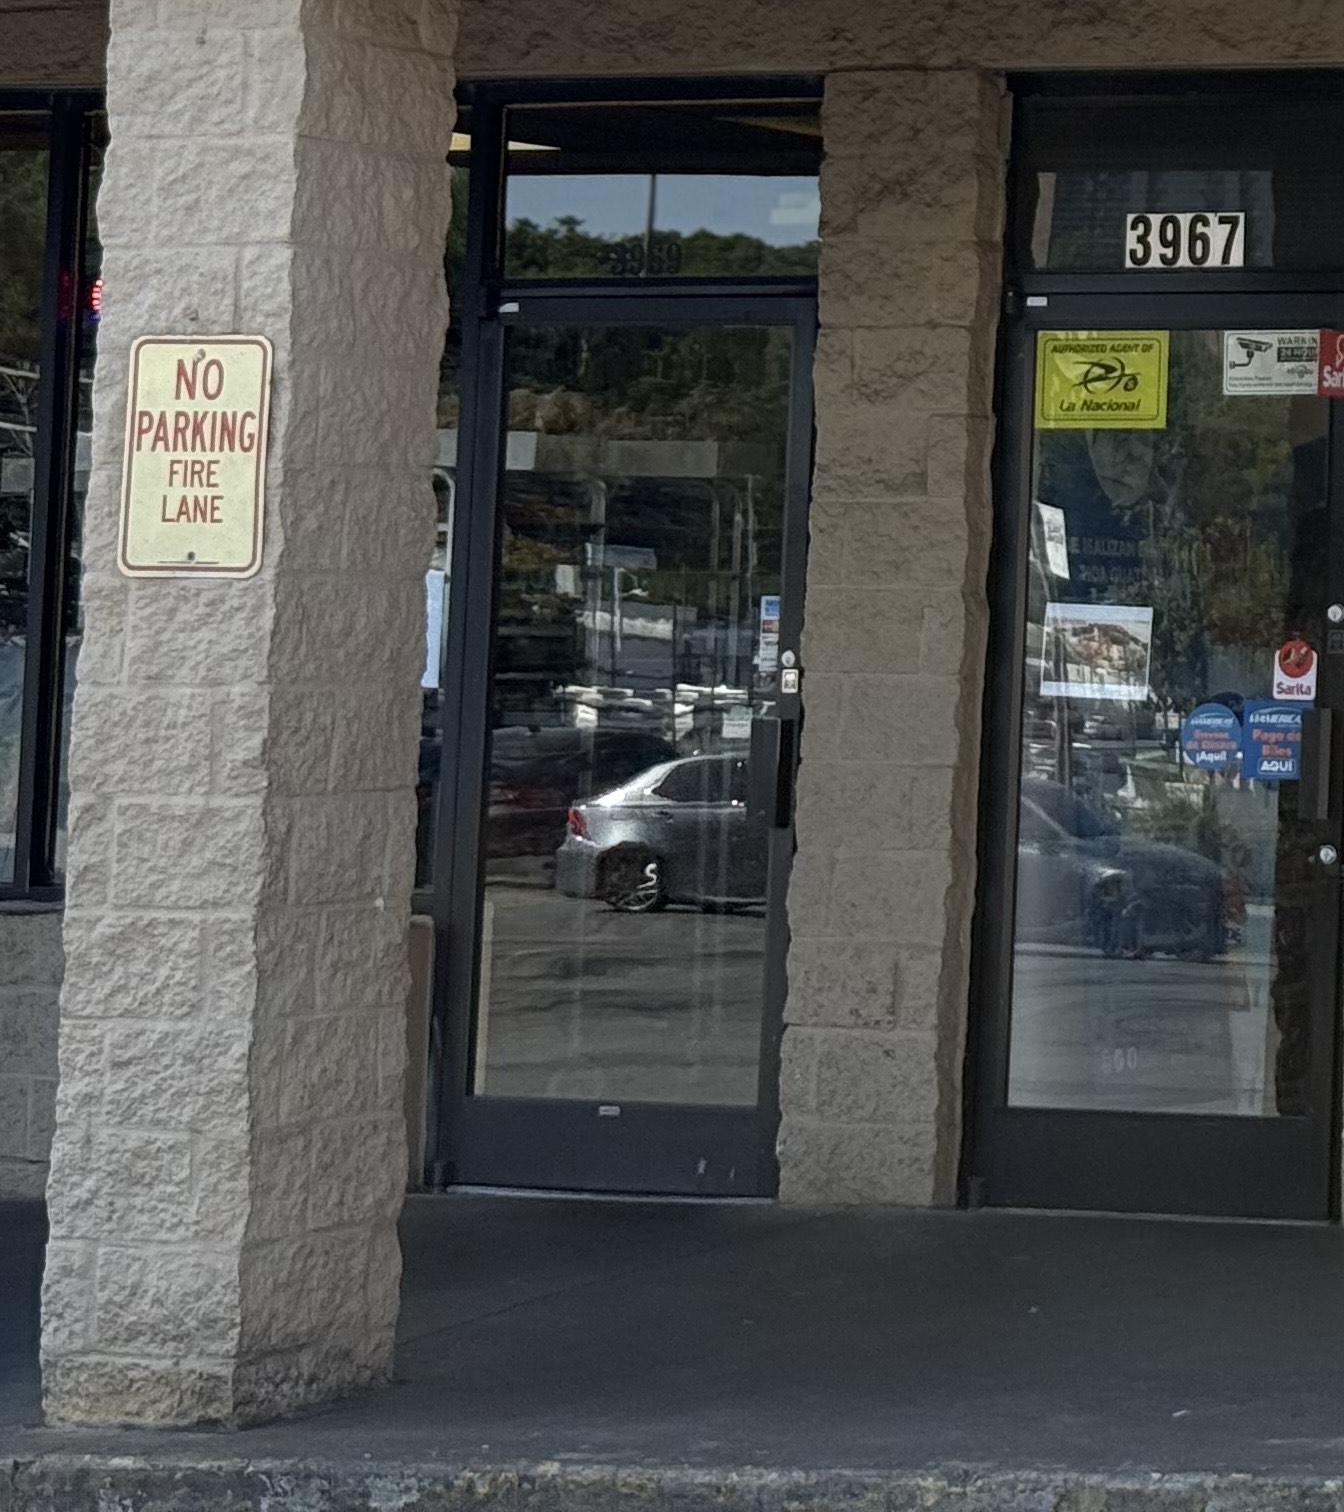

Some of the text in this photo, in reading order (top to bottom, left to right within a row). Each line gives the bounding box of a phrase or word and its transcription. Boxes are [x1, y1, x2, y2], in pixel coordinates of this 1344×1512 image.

[1129, 214, 1241, 266] 3967
[1051, 344, 1107, 353] AUTHORIZED
[1109, 344, 1139, 353] AGENT
[174, 358, 224, 401] NO
[1059, 398, 1141, 412] La Nacional
[136, 410, 257, 454] PARKING
[168, 459, 220, 489] FIRE
[161, 495, 224, 524] LANE
[1276, 682, 1312, 696] Sarita
